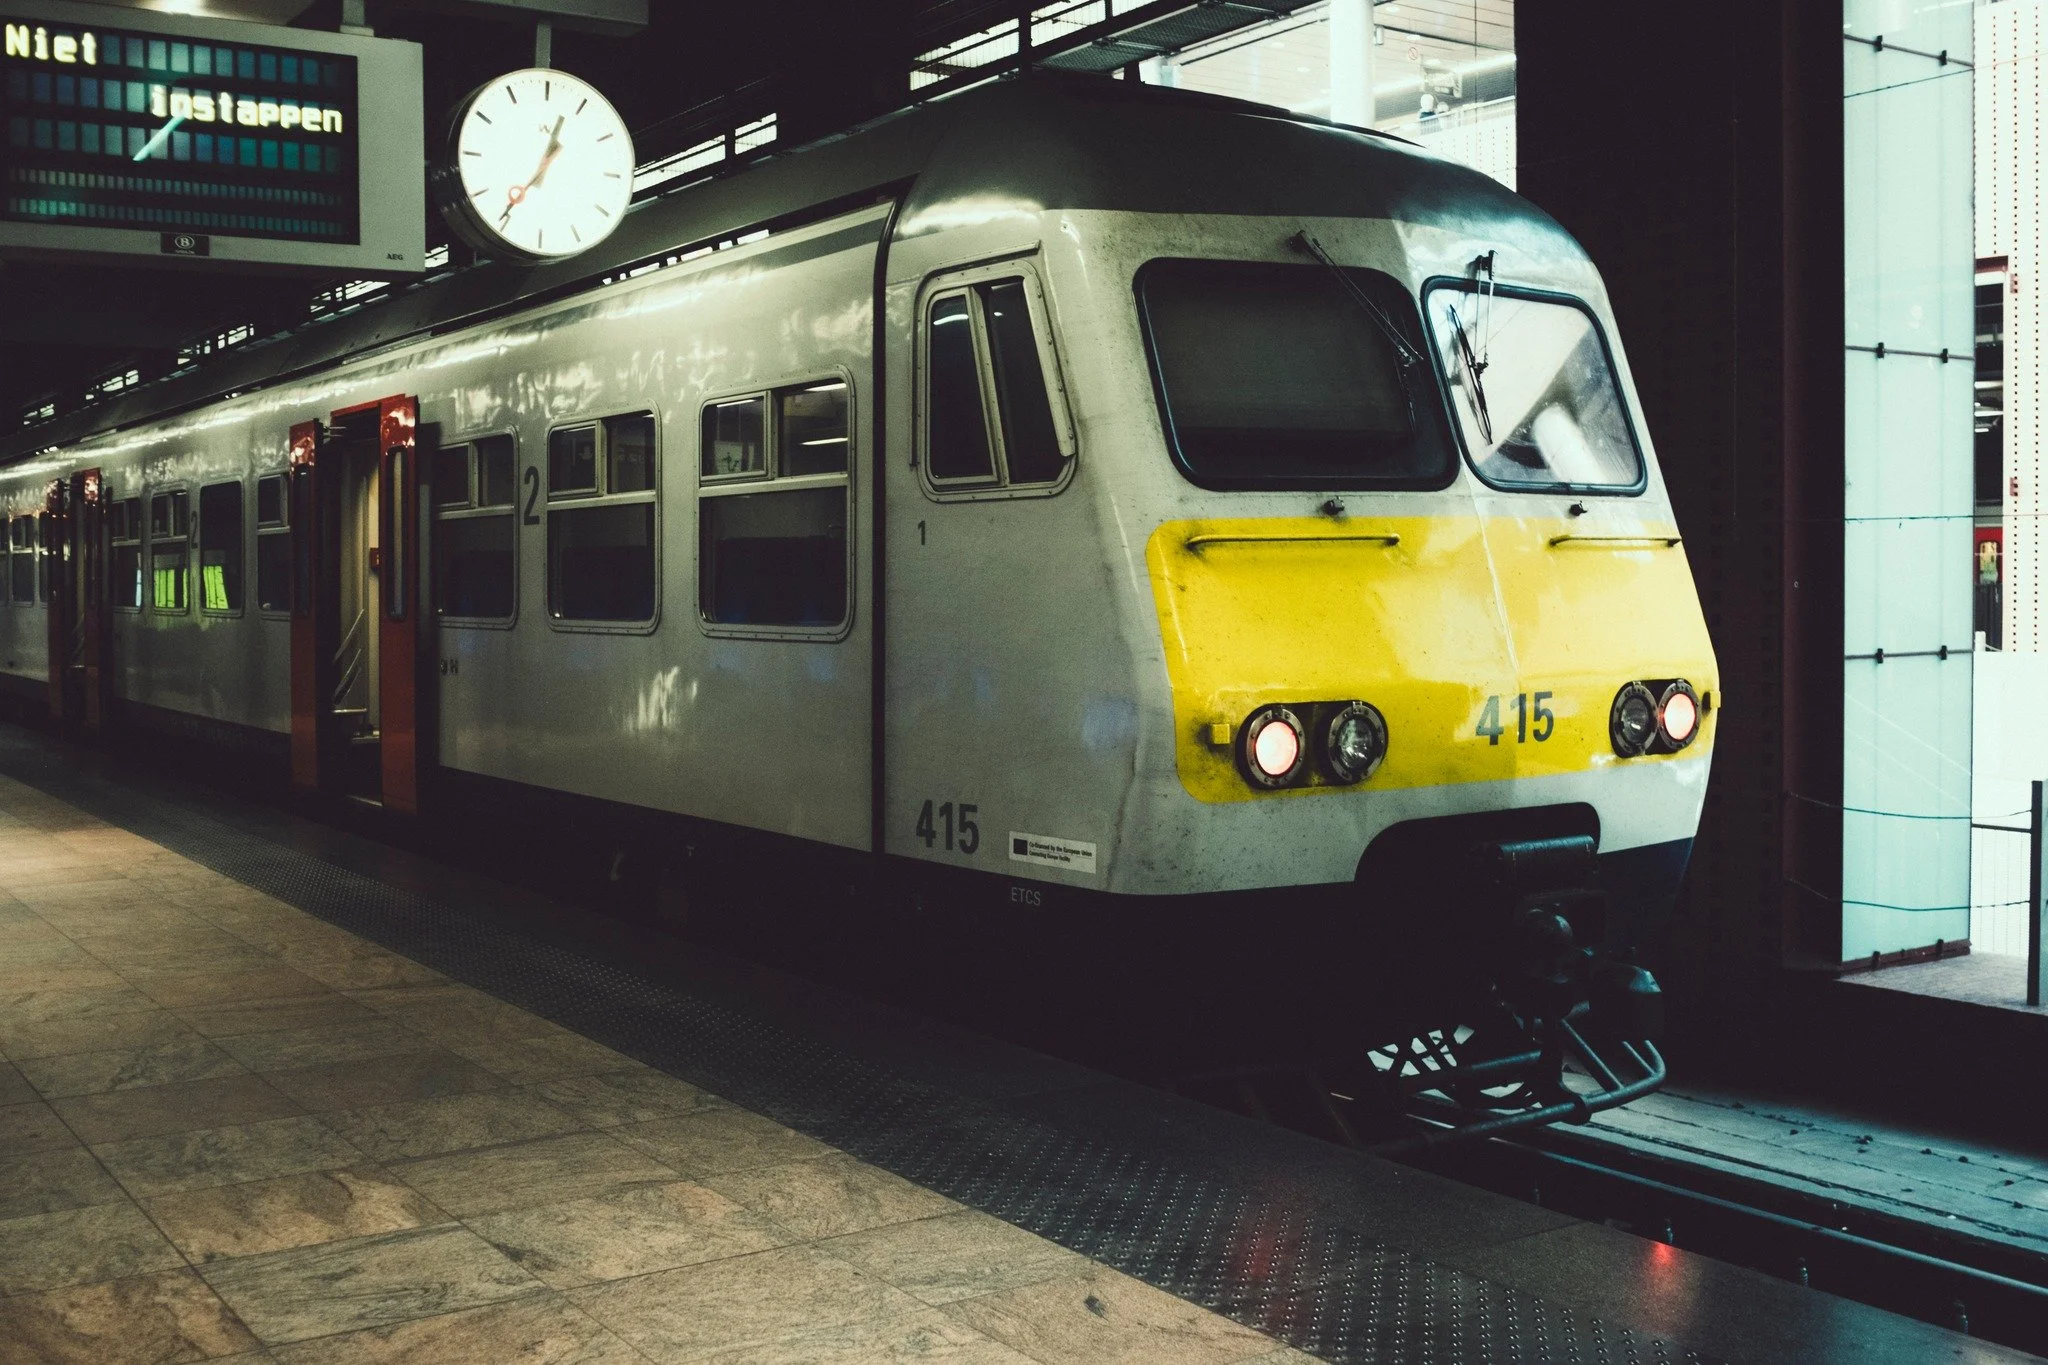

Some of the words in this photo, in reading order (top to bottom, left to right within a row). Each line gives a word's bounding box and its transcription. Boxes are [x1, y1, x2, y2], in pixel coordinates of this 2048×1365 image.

[5, 23, 97, 66] Niet
[151, 83, 343, 133] instappen
[523, 465, 540, 526] 2
[190, 510, 198, 550] 2
[917, 520, 926, 546] 1
[1474, 690, 1555, 746] 415
[915, 799, 980, 855] 415
[1011, 886, 1041, 906] ETCS
